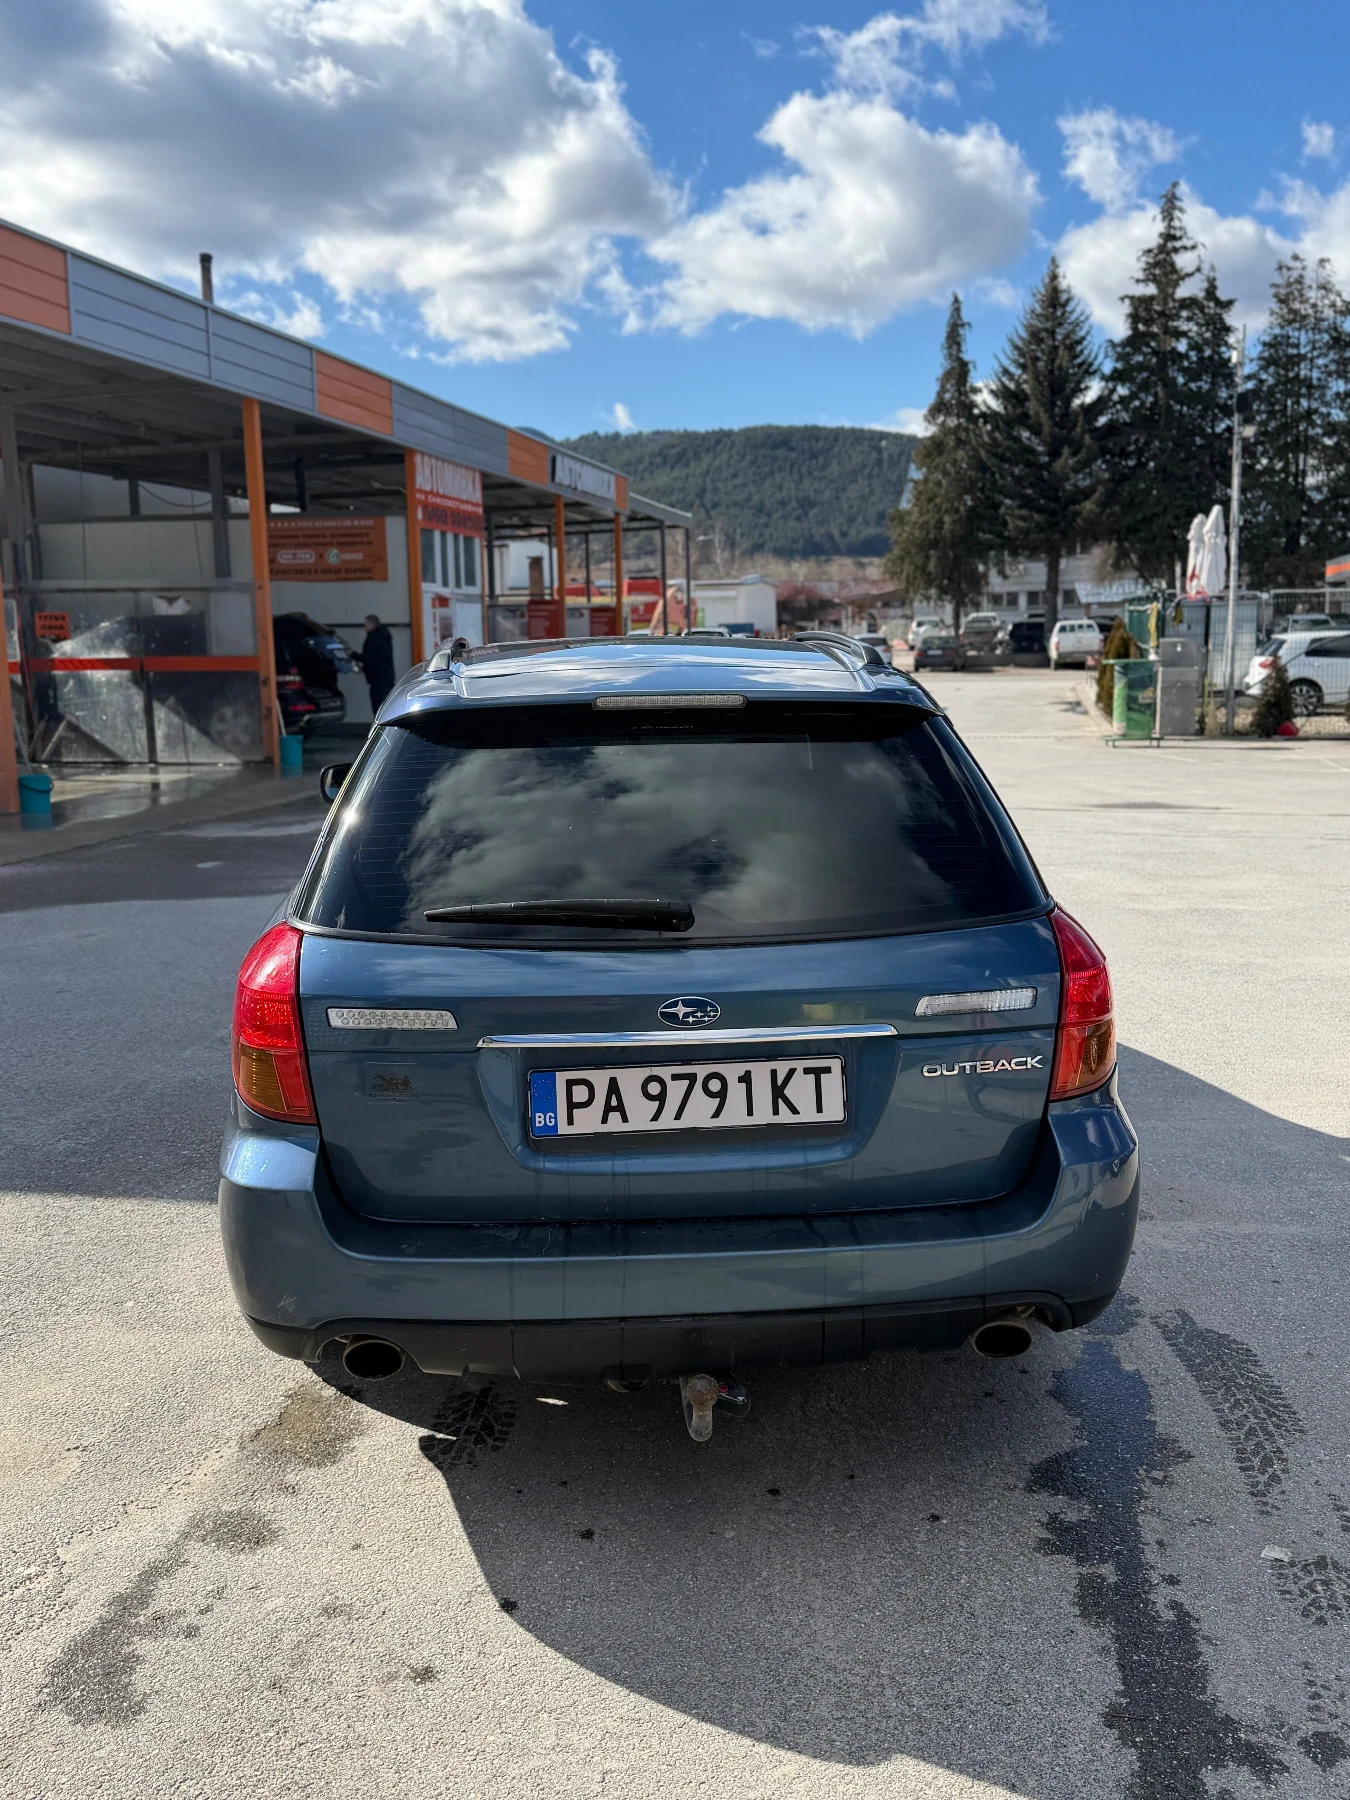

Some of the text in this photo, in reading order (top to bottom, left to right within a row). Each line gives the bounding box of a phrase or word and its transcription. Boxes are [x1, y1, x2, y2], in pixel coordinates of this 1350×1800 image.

[414, 452, 483, 503] АВТОМИВКА
[922, 1055, 1044, 1077] OUTBACK
[640, 1069, 754, 1123] 9791
[535, 1112, 556, 1128] BG
